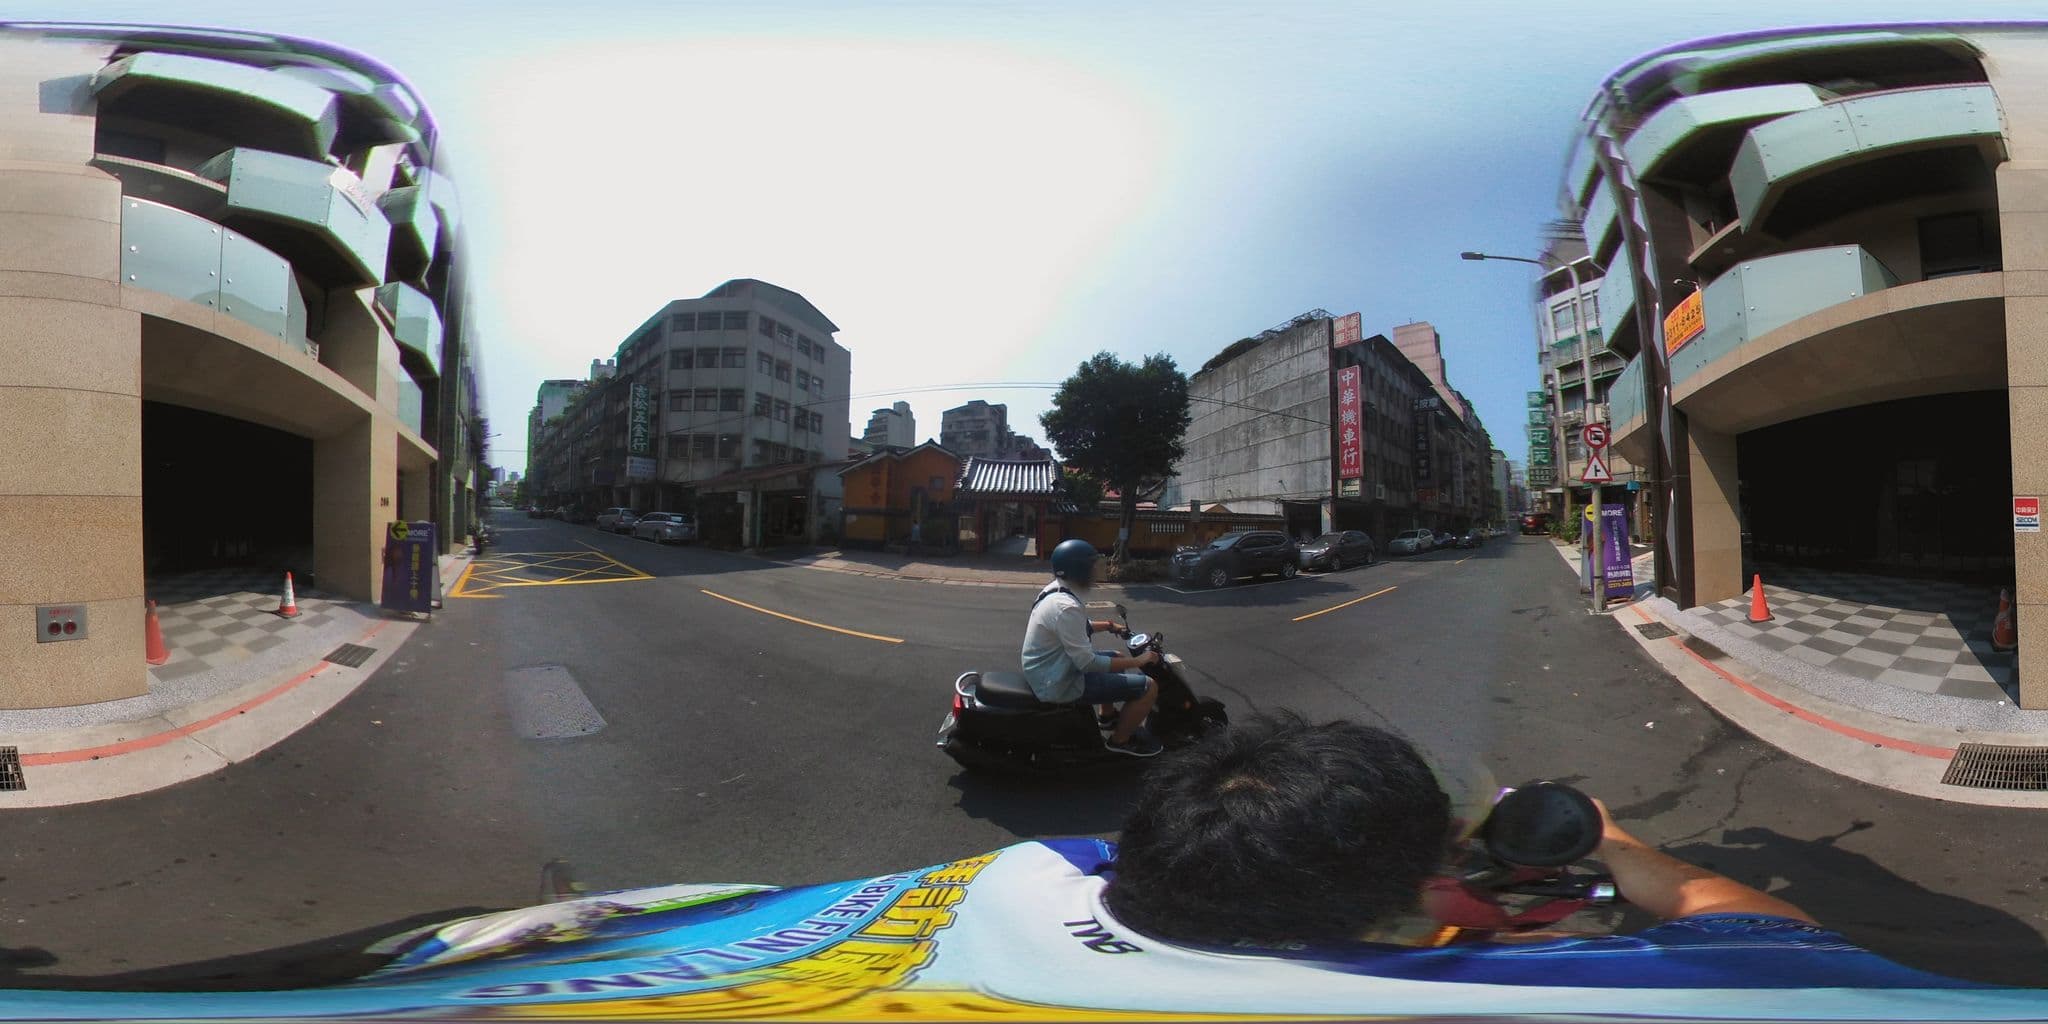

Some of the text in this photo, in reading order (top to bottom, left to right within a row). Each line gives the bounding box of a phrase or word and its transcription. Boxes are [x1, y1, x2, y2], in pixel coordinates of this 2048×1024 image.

[1341, 370, 1358, 466] 中華機車行
[820, 883, 897, 919] BIKE
[732, 919, 851, 953] FUN
